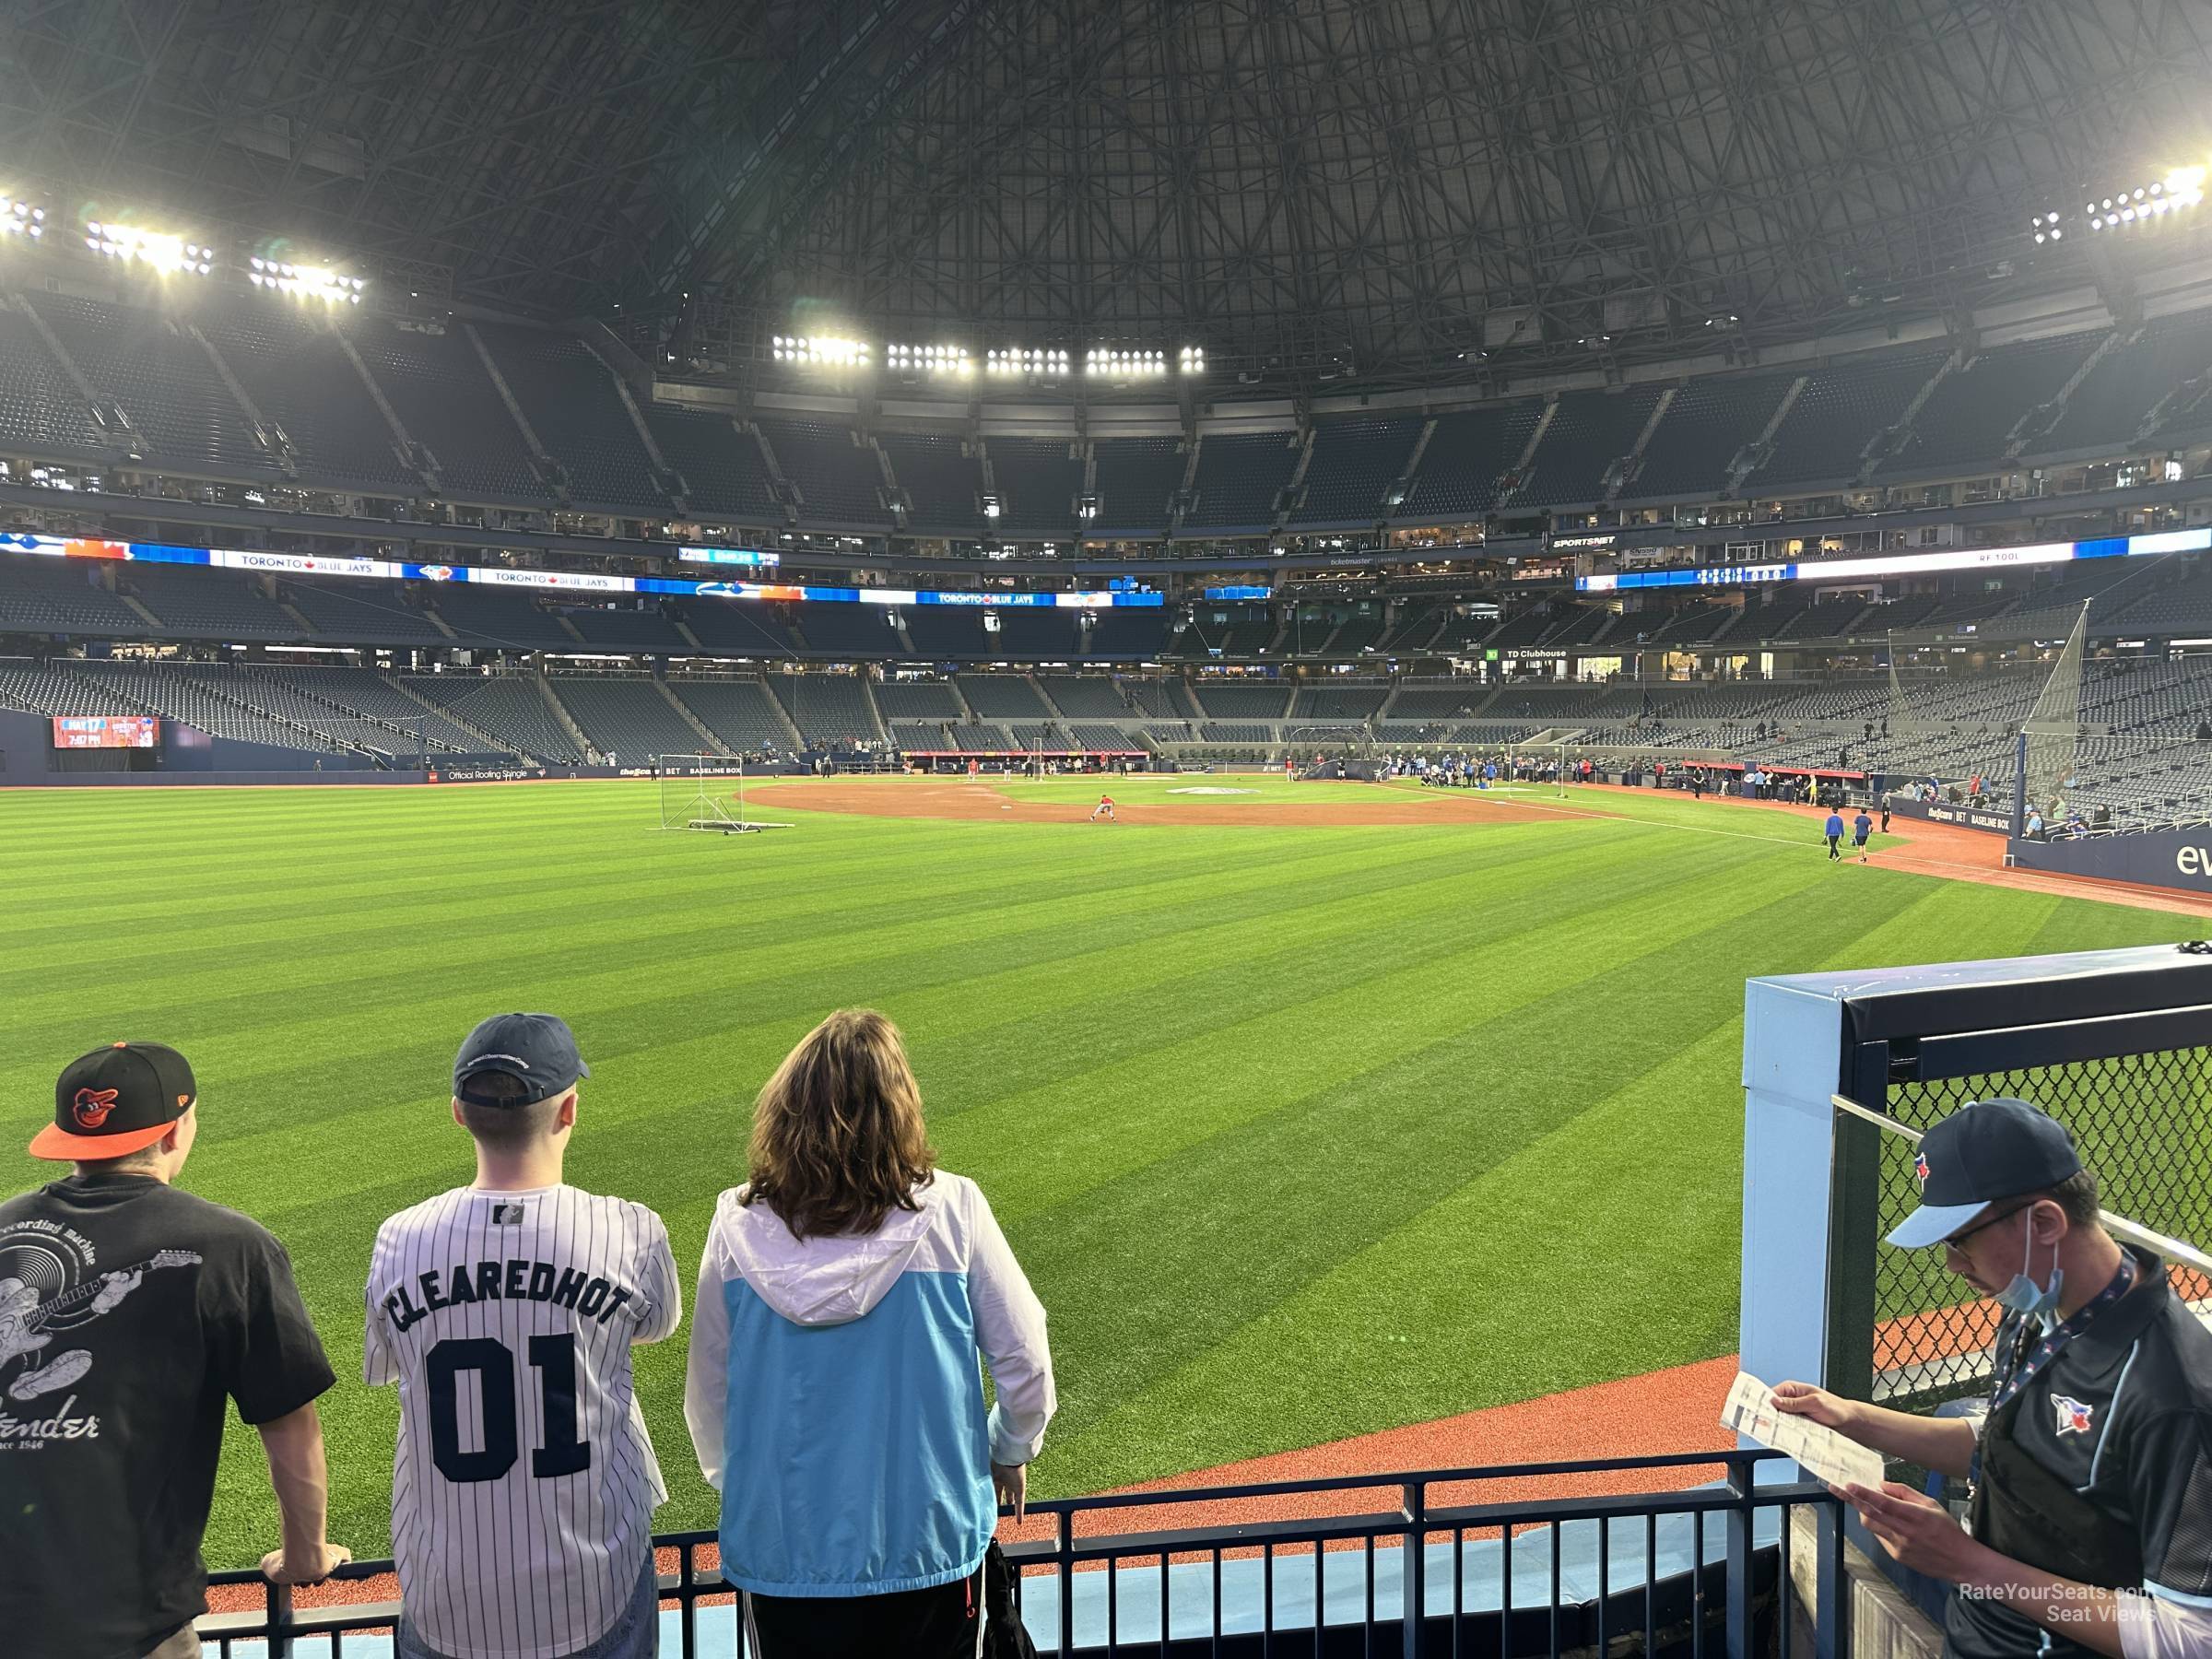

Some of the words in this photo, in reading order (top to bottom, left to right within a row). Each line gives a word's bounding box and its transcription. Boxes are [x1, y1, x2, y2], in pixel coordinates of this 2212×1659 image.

[1553, 535, 1616, 548] SPORTSNET
[241, 555, 302, 569] TORONTO
[317, 562, 344, 571] BLUE
[347, 564, 372, 573] JAYS
[495, 571, 547, 583] TORONTO
[585, 578, 608, 587] JAYS
[939, 594, 982, 604] TORONTO
[992, 594, 1012, 604] BLUE
[1014, 594, 1034, 604] JAYS
[1520, 650, 1567, 658] Clubhouse
[448, 771, 474, 780] Official
[475, 770, 500, 780] Roofing
[619, 767, 661, 777] theScoe
[1956, 811, 1967, 823] BET
[1971, 815, 1997, 828] BASELINE
[1997, 819, 2009, 830] BOX
[0, 1219, 65, 1234] ecording
[64, 1228, 96, 1266] machine
[387, 1259, 632, 1333] CLEAREDHOT
[0, 1394, 99, 1438] ender
[426, 1333, 591, 1483] 01
